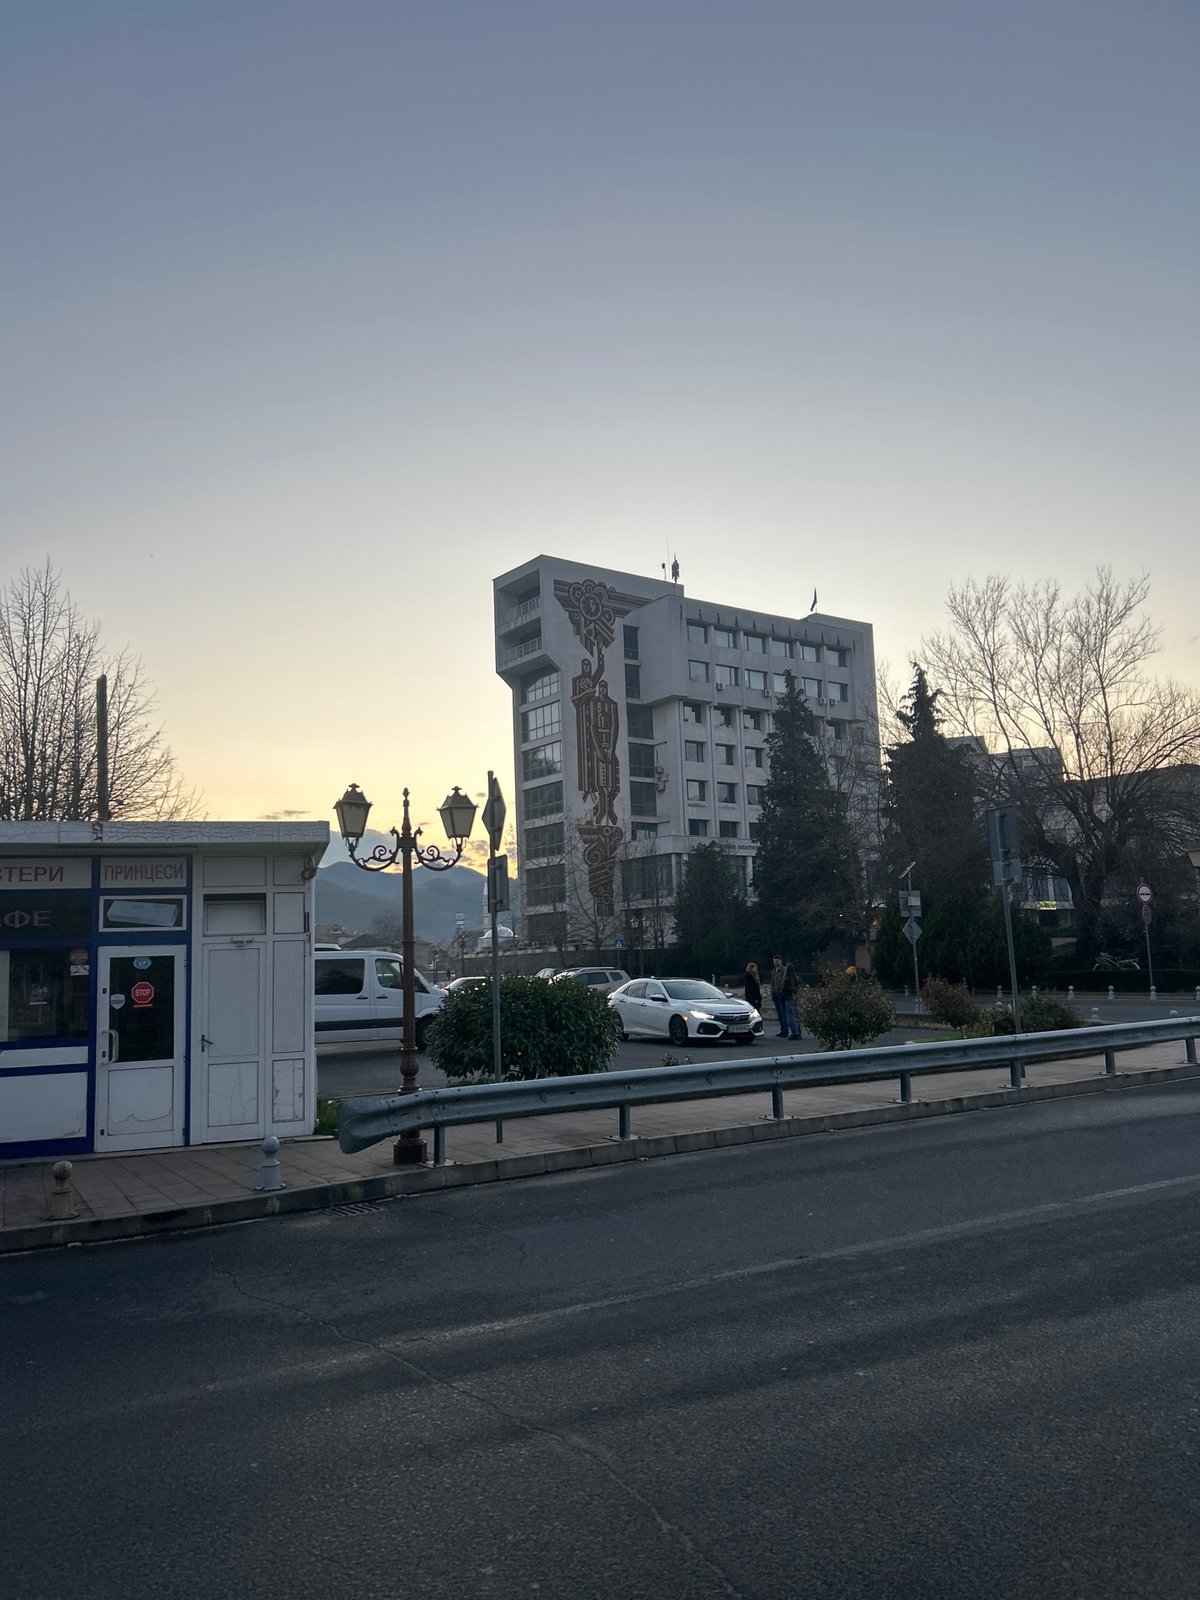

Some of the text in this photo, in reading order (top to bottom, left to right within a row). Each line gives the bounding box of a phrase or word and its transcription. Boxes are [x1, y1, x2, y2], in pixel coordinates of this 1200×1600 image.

[0, 866, 65, 883] ТЕРИ
[104, 863, 183, 883] ПРИНЦЕСИ
[0, 909, 52, 929] ФЕ
[134, 988, 151, 997] STOP
